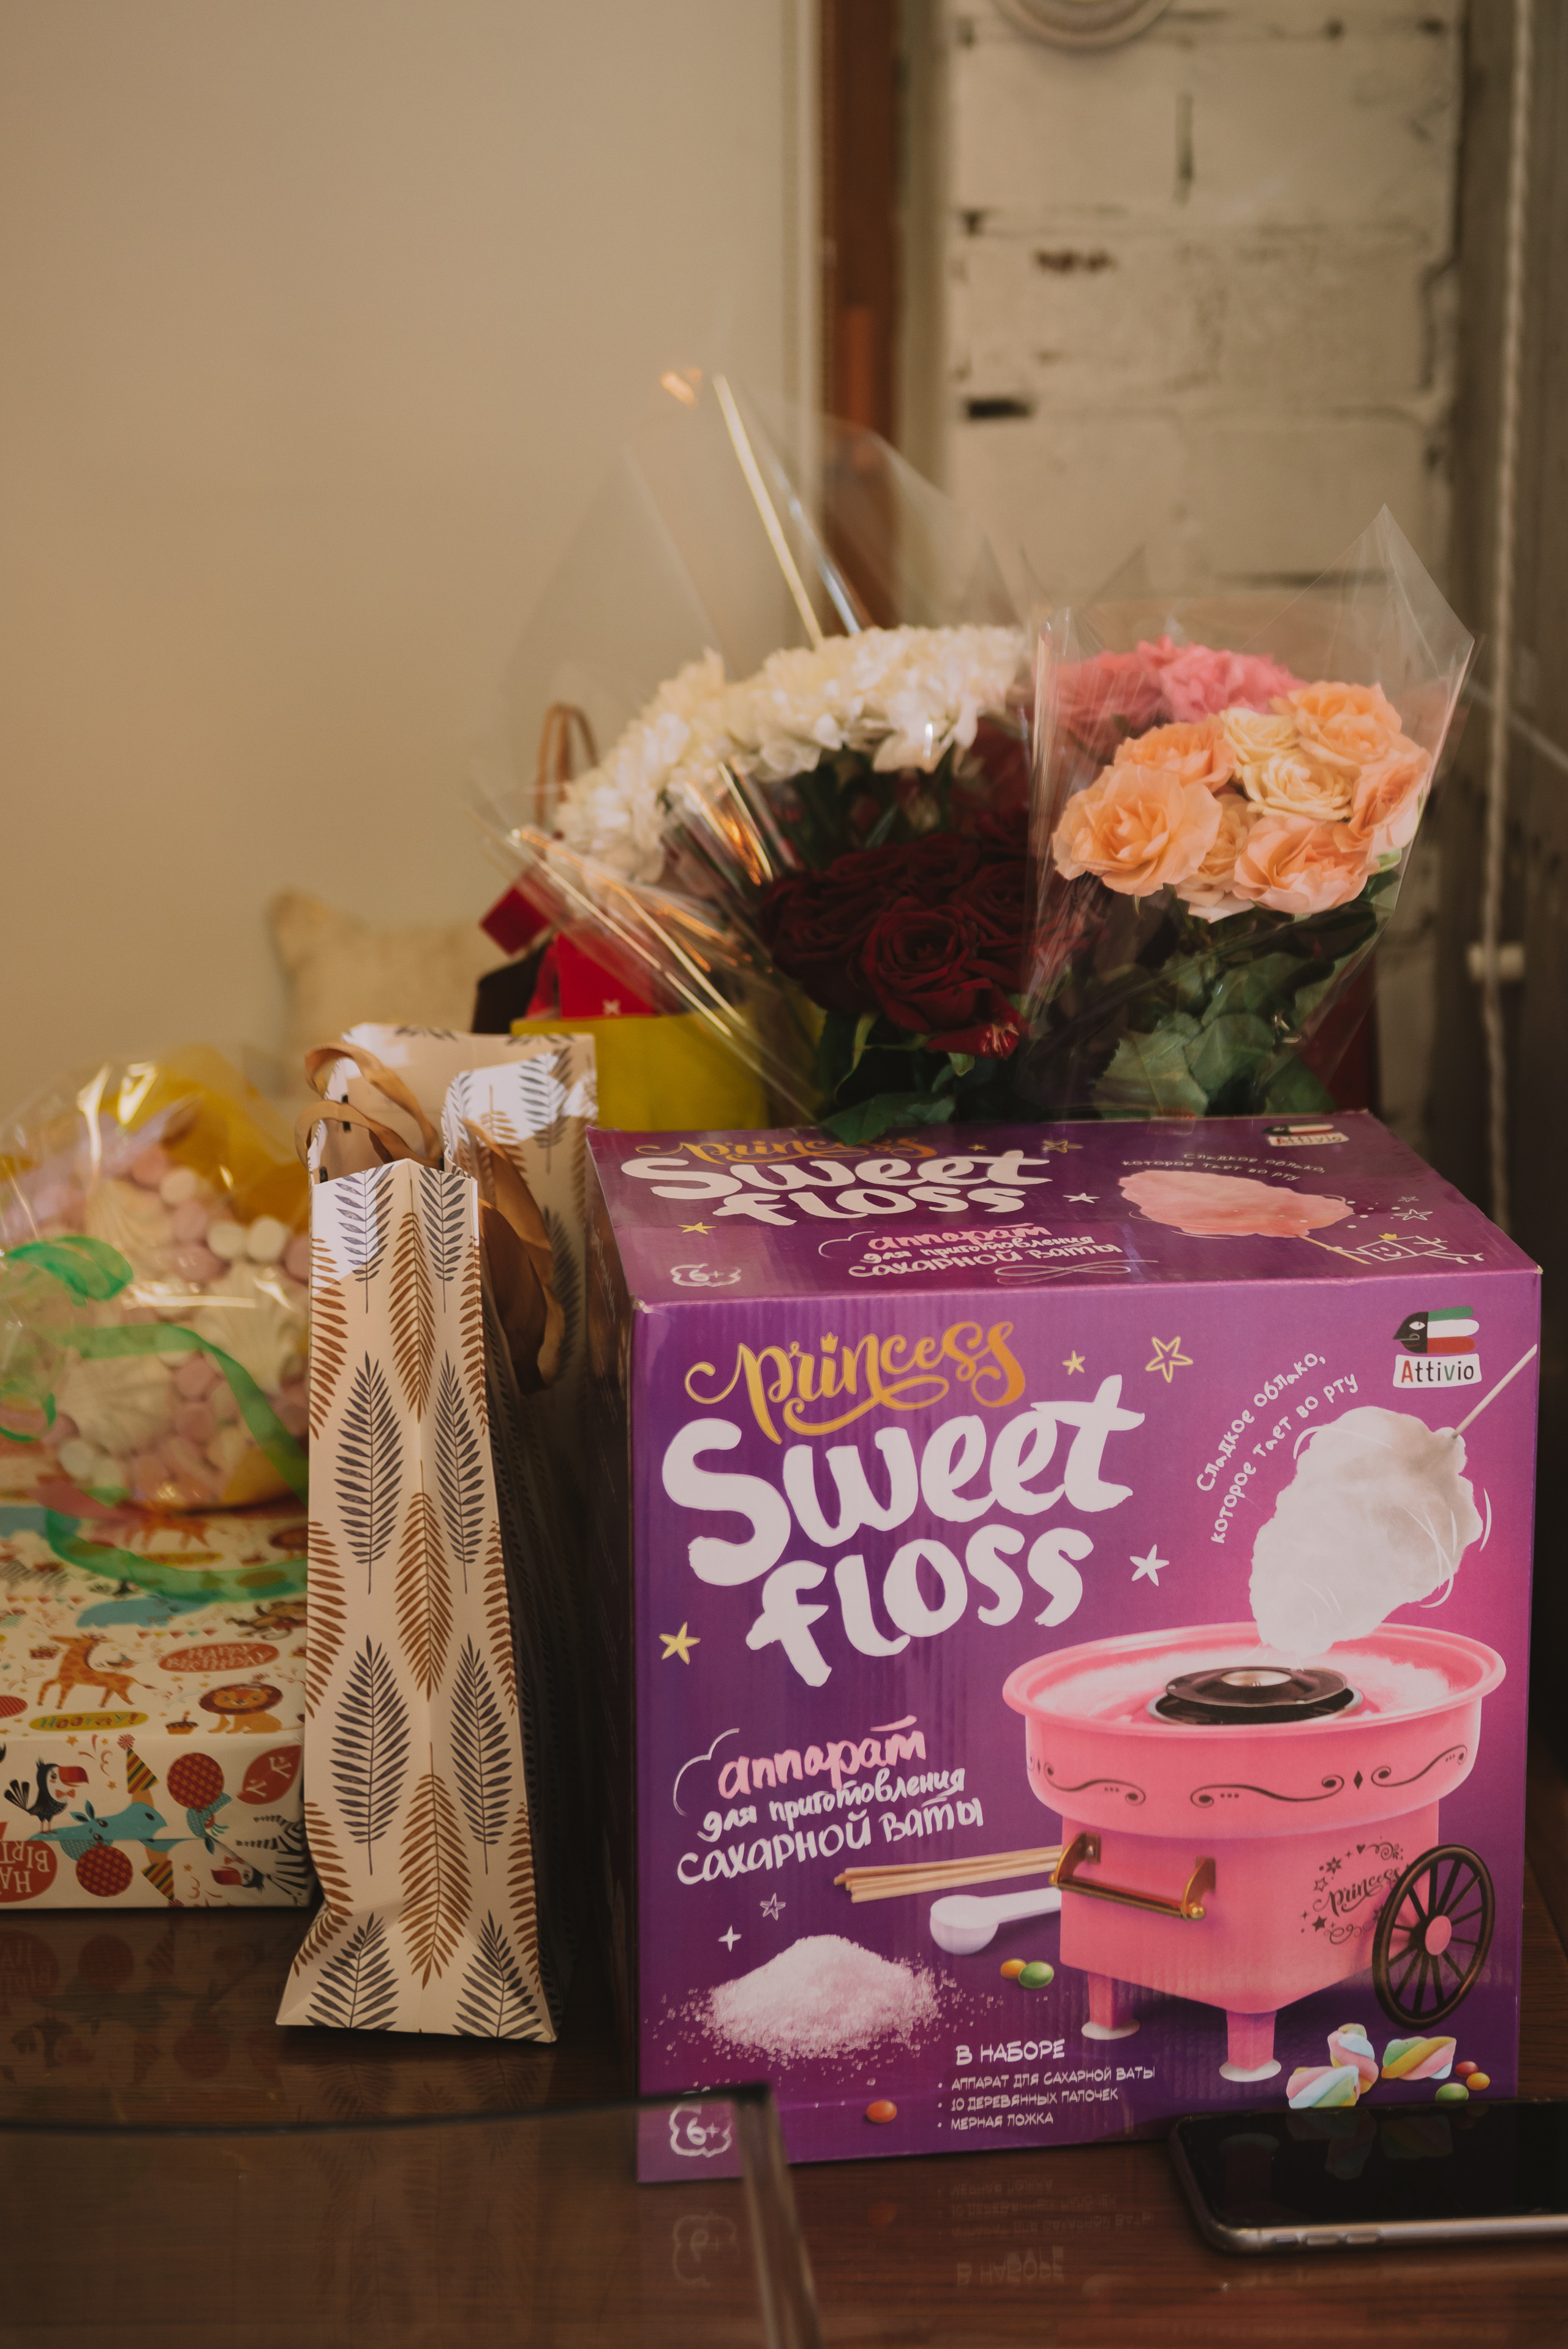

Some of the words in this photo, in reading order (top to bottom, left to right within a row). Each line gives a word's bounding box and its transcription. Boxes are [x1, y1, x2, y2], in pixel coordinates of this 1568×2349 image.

[620, 1149, 1052, 1200] Sweet
[689, 1269, 724, 1282] 6+
[1401, 1360, 1474, 1383] Attivio
[662, 1374, 1145, 1586] Sweet
[956, 2044, 972, 2065] В
[980, 2038, 1065, 2063] НАБОРЕ
[951, 2074, 1009, 2091] АППАРАТ
[1013, 2073, 1039, 2089] ДЛЯ
[1043, 2065, 1112, 2086] САХАРНОЙ
[1116, 2065, 1155, 2081] ВАТЫ
[951, 2097, 965, 2111] 10
[967, 2090, 1058, 2111] ДЕРЕВЯННЫХ
[1061, 2087, 1118, 2103] ПАЛОЧЕК
[687, 2116, 721, 2146] 6+
[951, 2114, 1003, 2130] МЕРНАЯ
[1008, 2111, 1054, 2127] ЛОЖКА
